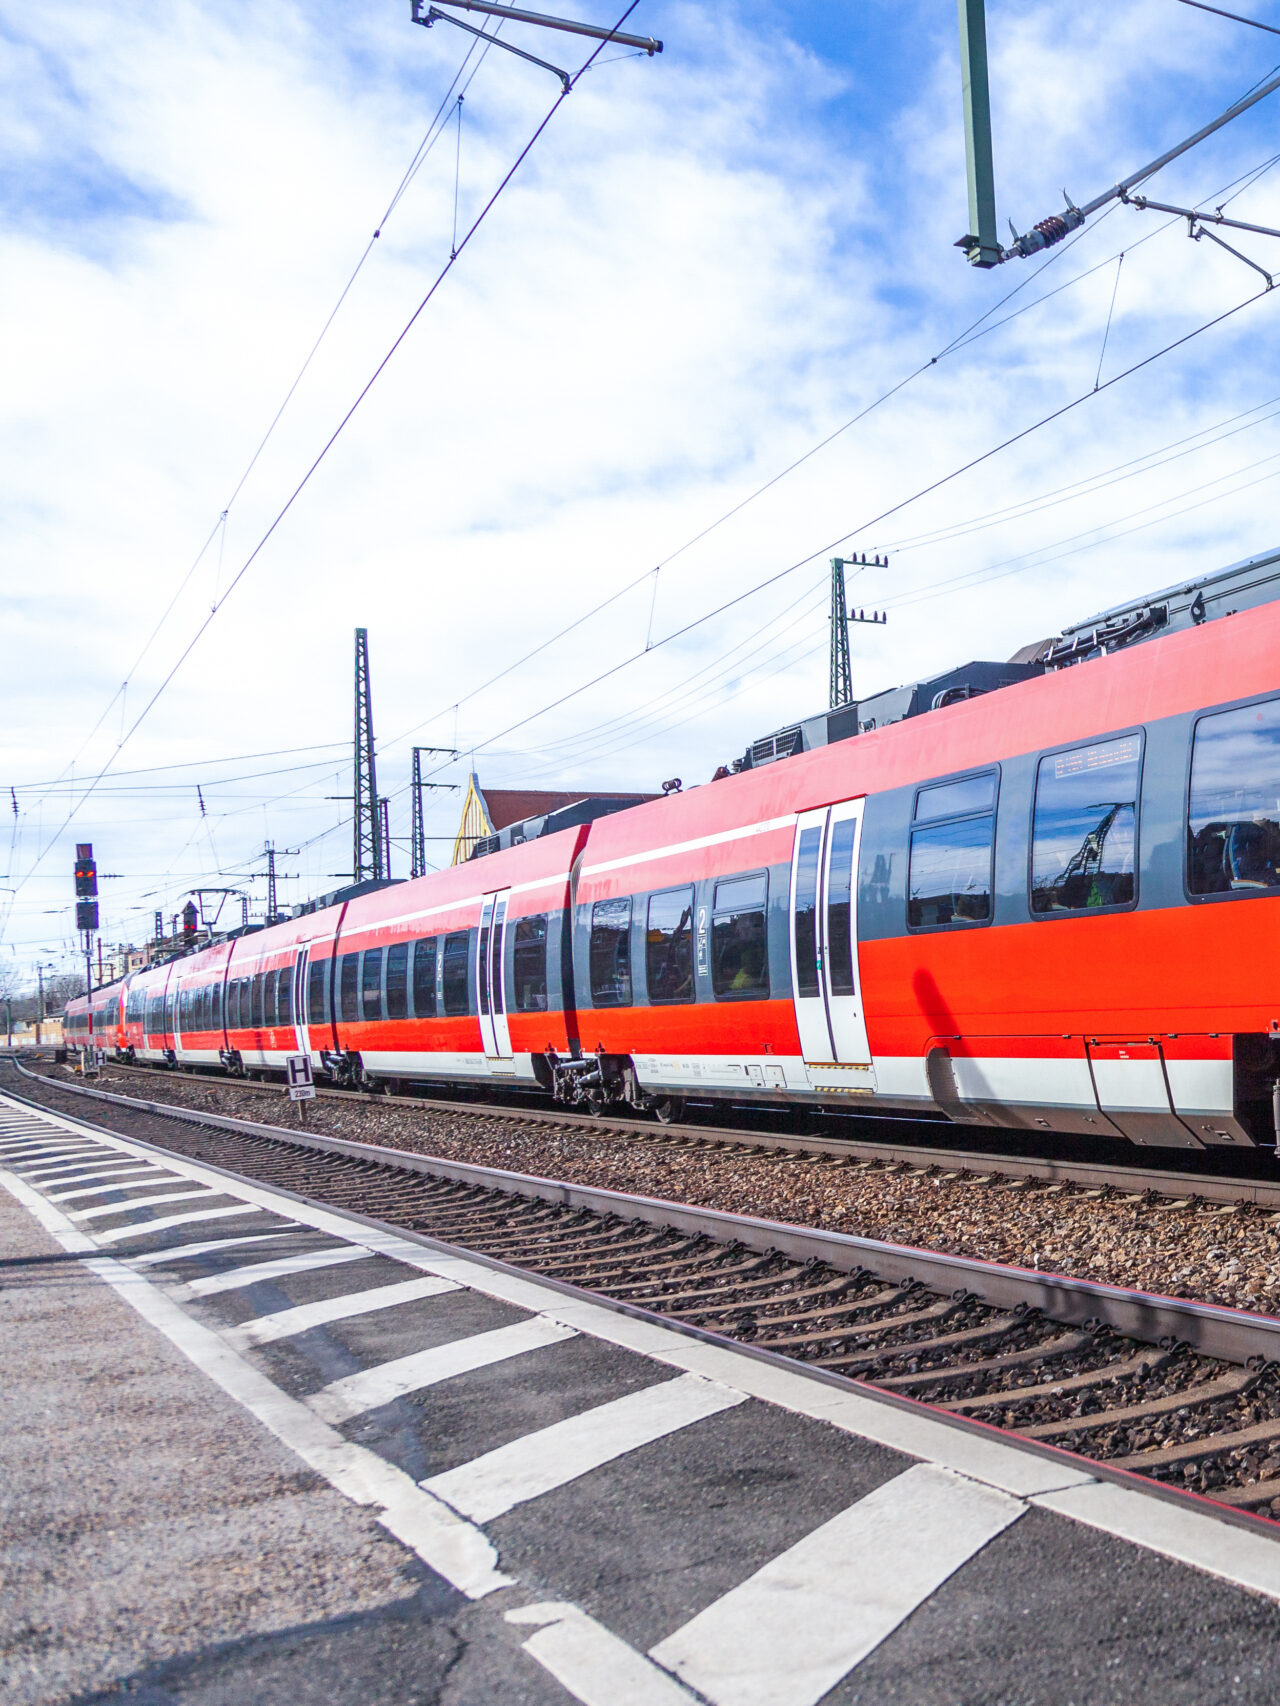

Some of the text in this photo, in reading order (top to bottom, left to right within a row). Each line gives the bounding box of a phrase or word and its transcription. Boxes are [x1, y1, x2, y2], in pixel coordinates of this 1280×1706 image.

[699, 909, 706, 934] 2
[96, 1052, 105, 1065] H
[290, 1057, 311, 1084] H
